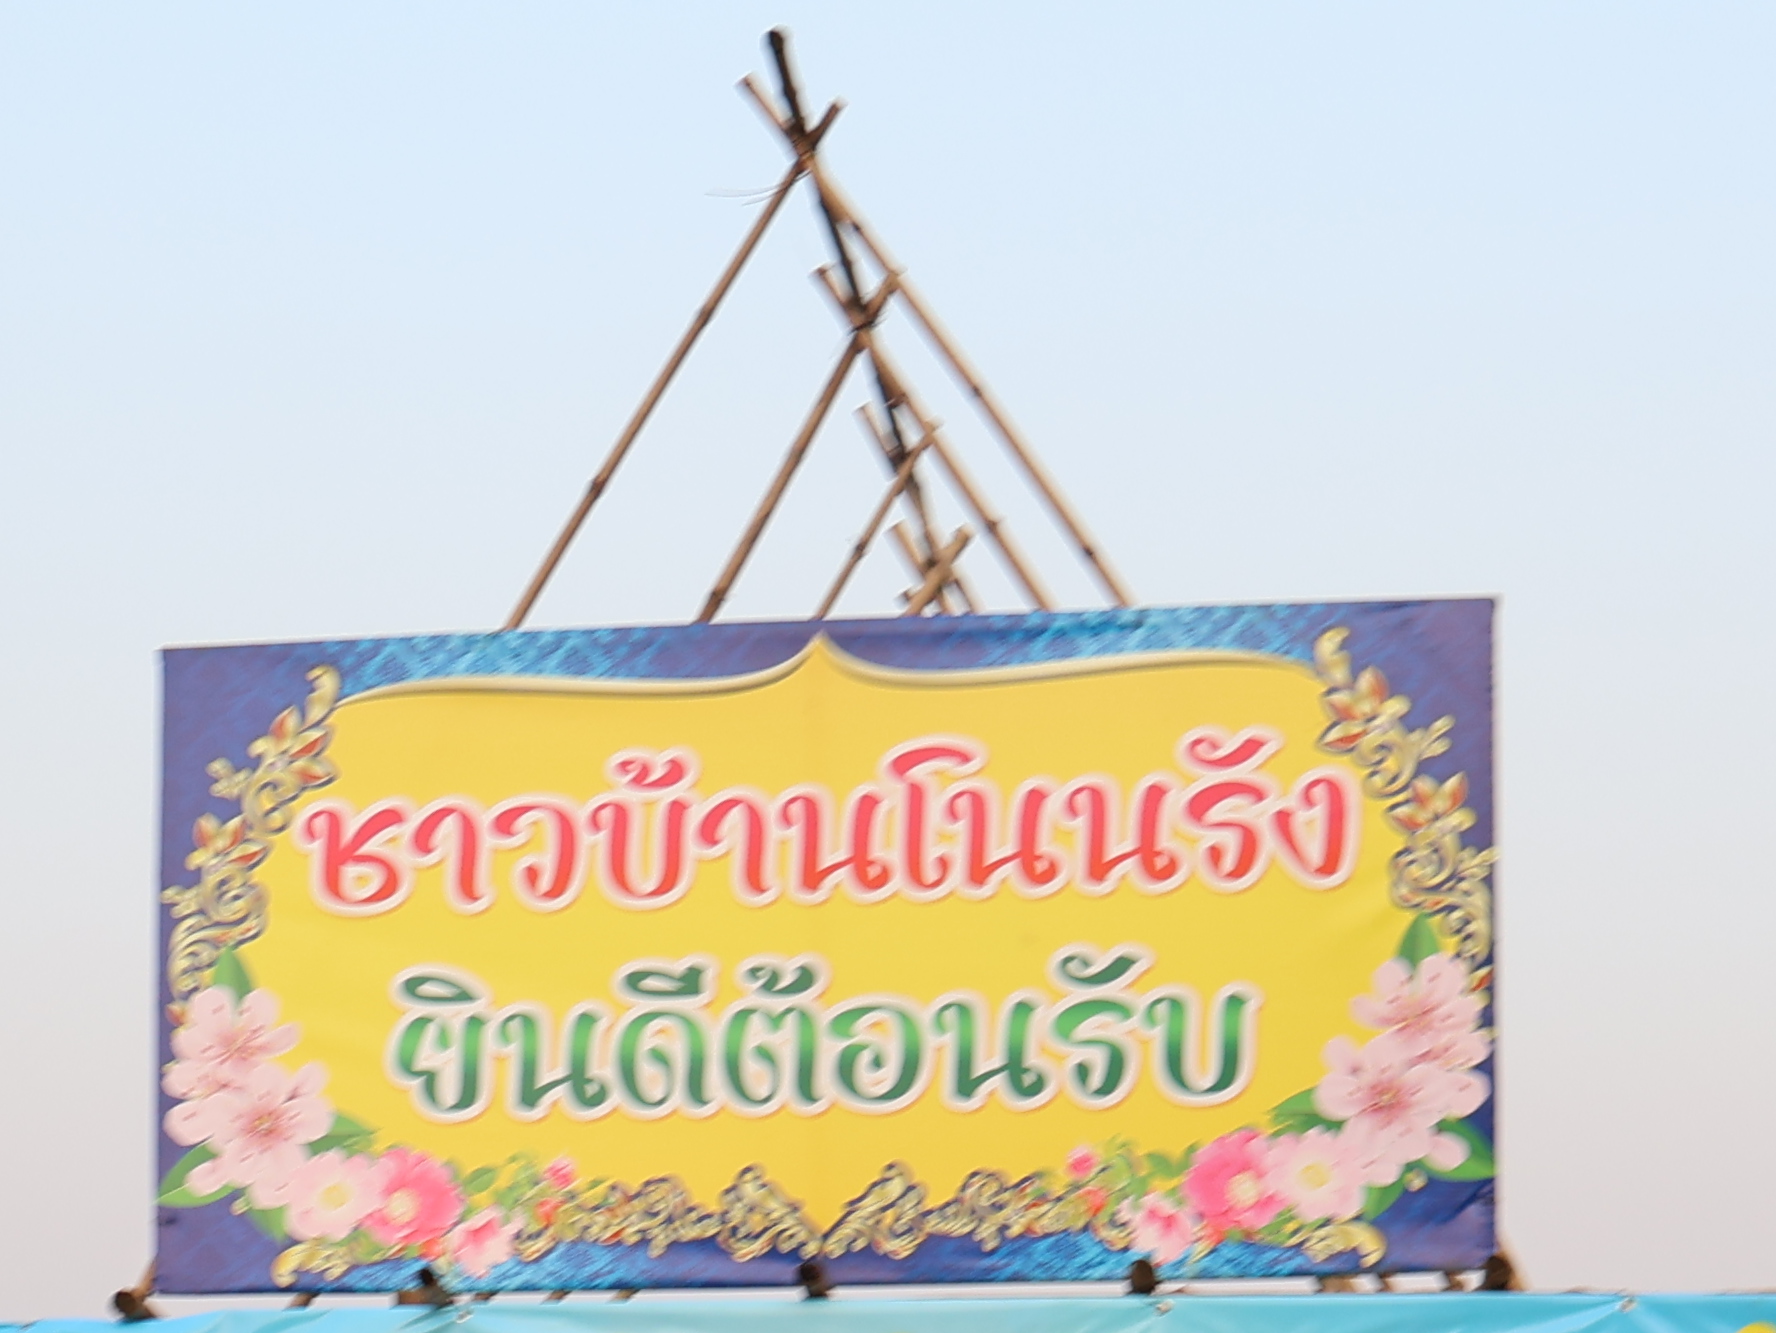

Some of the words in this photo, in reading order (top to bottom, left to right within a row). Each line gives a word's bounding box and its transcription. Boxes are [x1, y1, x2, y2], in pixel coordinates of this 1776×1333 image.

[304, 731, 1352, 908] ชาวบ้านโนนรัง
[394, 950, 1254, 1114] ยินดีต้อนรับ
